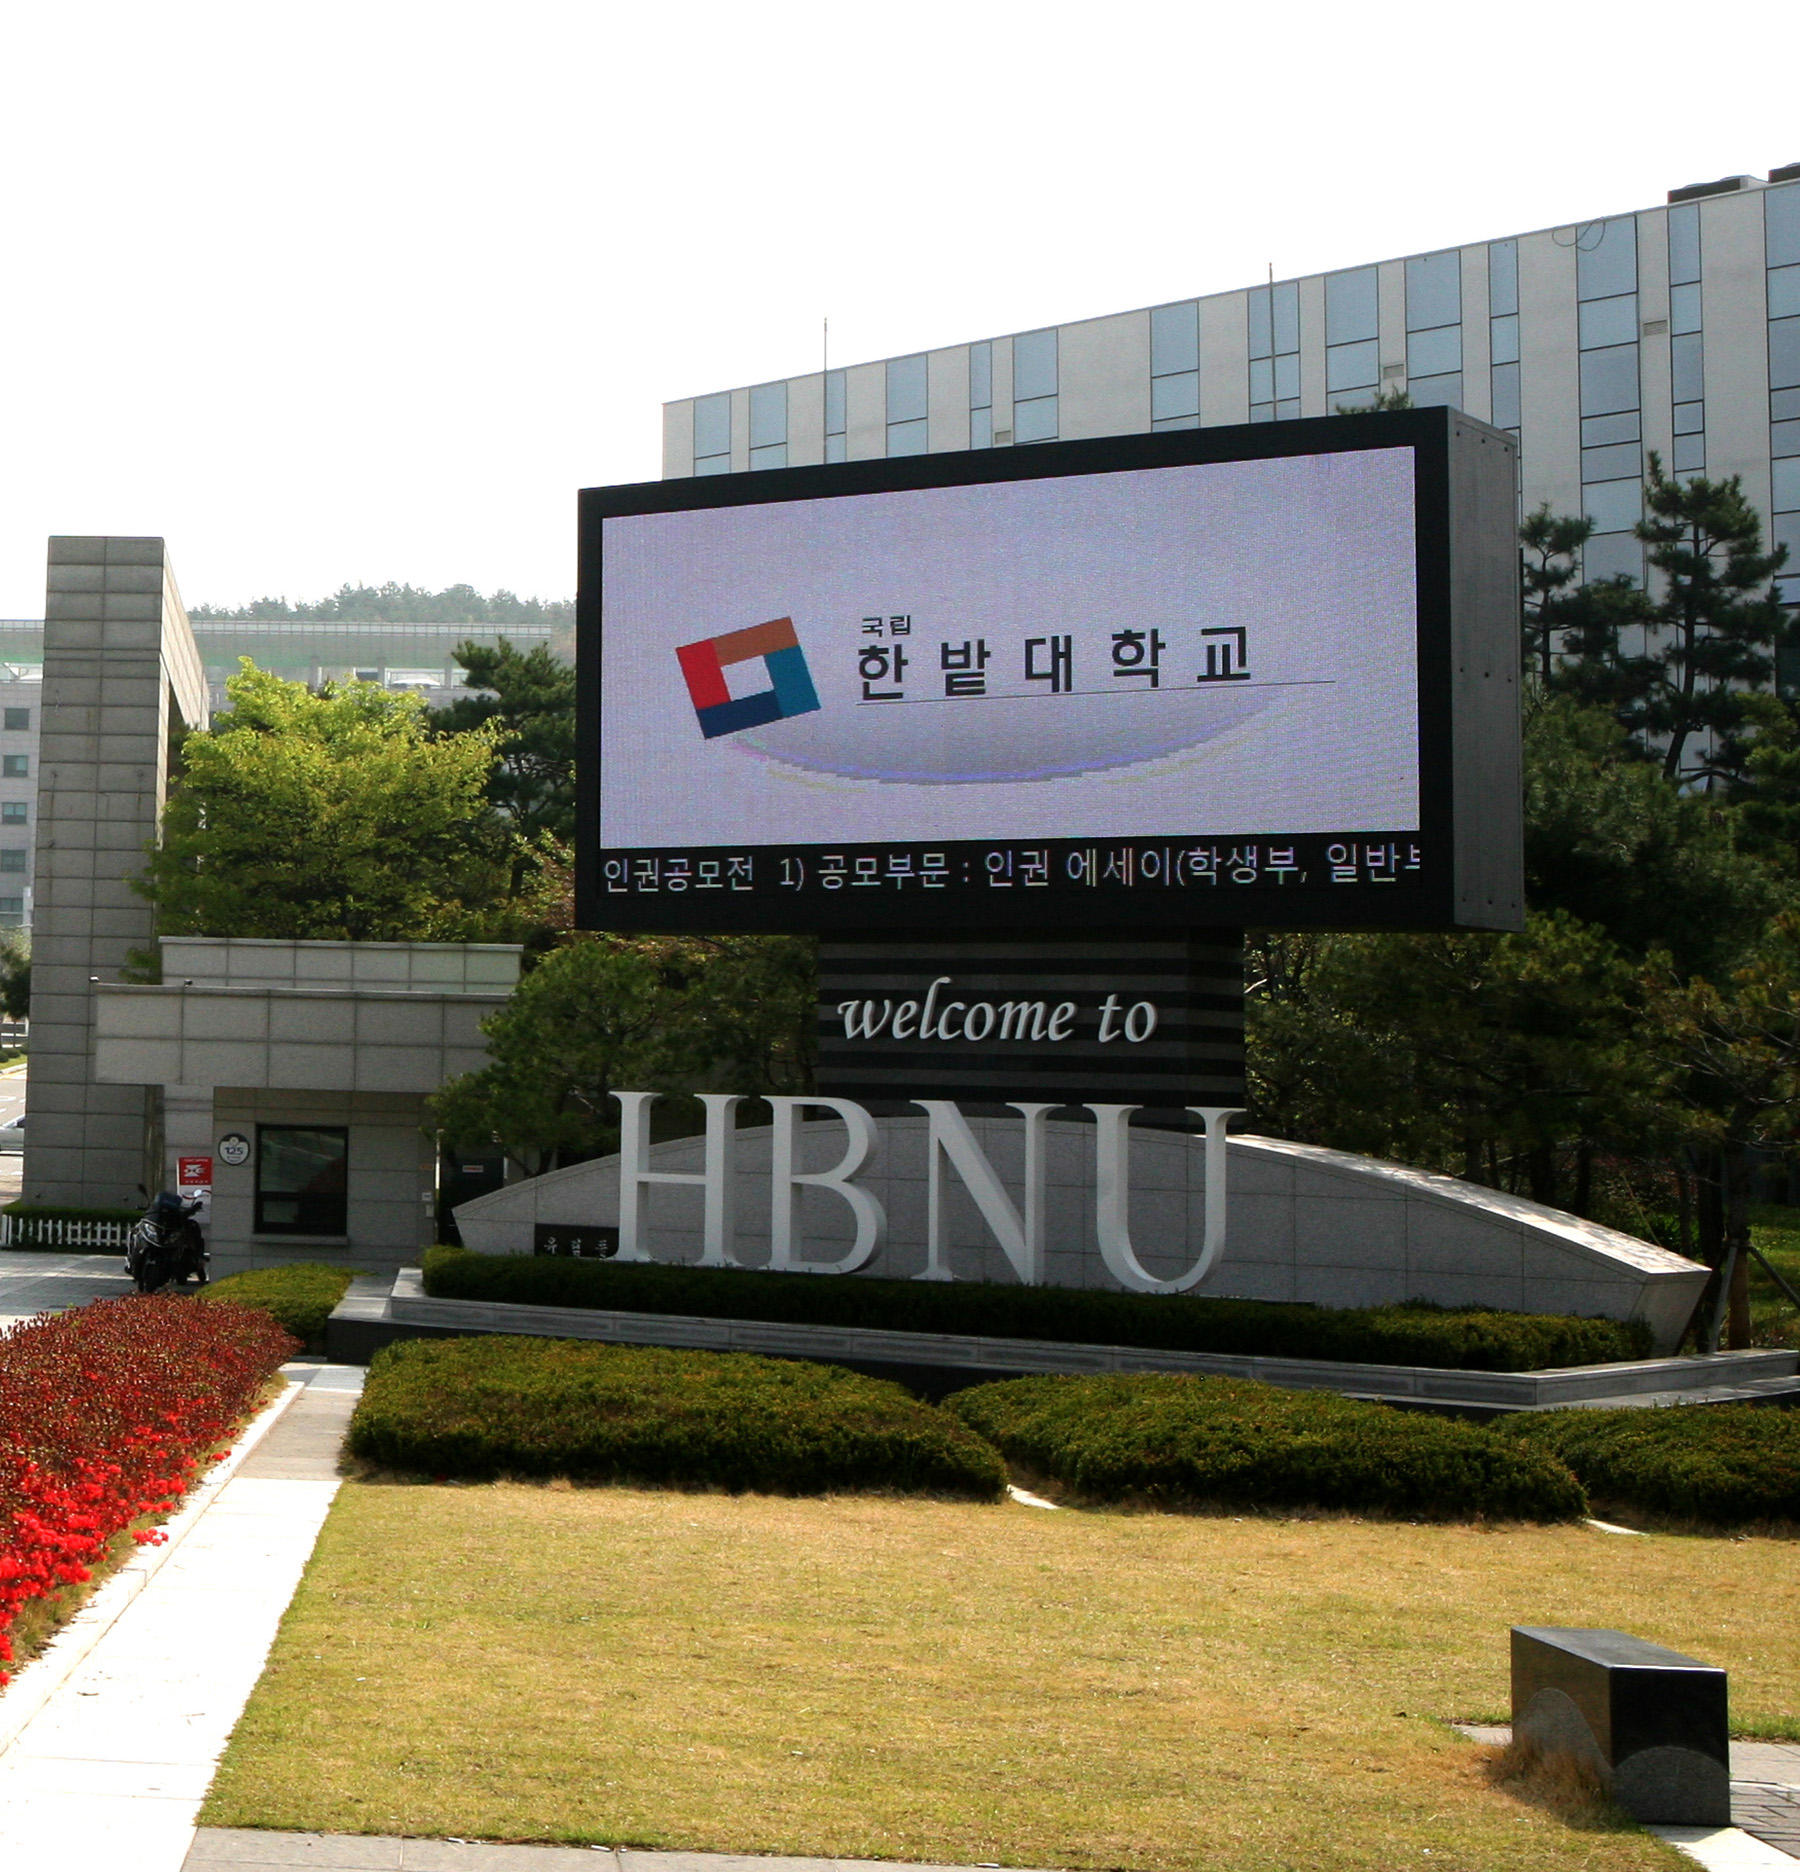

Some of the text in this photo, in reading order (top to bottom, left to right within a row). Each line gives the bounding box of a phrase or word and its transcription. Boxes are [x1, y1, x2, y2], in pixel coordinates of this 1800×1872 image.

[861, 614, 911, 638] 국립
[857, 626, 1252, 702] 한밭대학교
[603, 855, 754, 893] 인권공모전
[779, 857, 805, 892] 1)
[817, 852, 951, 890] 공모부문
[984, 849, 1050, 888] 인권
[837, 976, 1157, 1042] welcome to
[225, 1146, 244, 1155] 125
[608, 1090, 1248, 1294] HBNU
